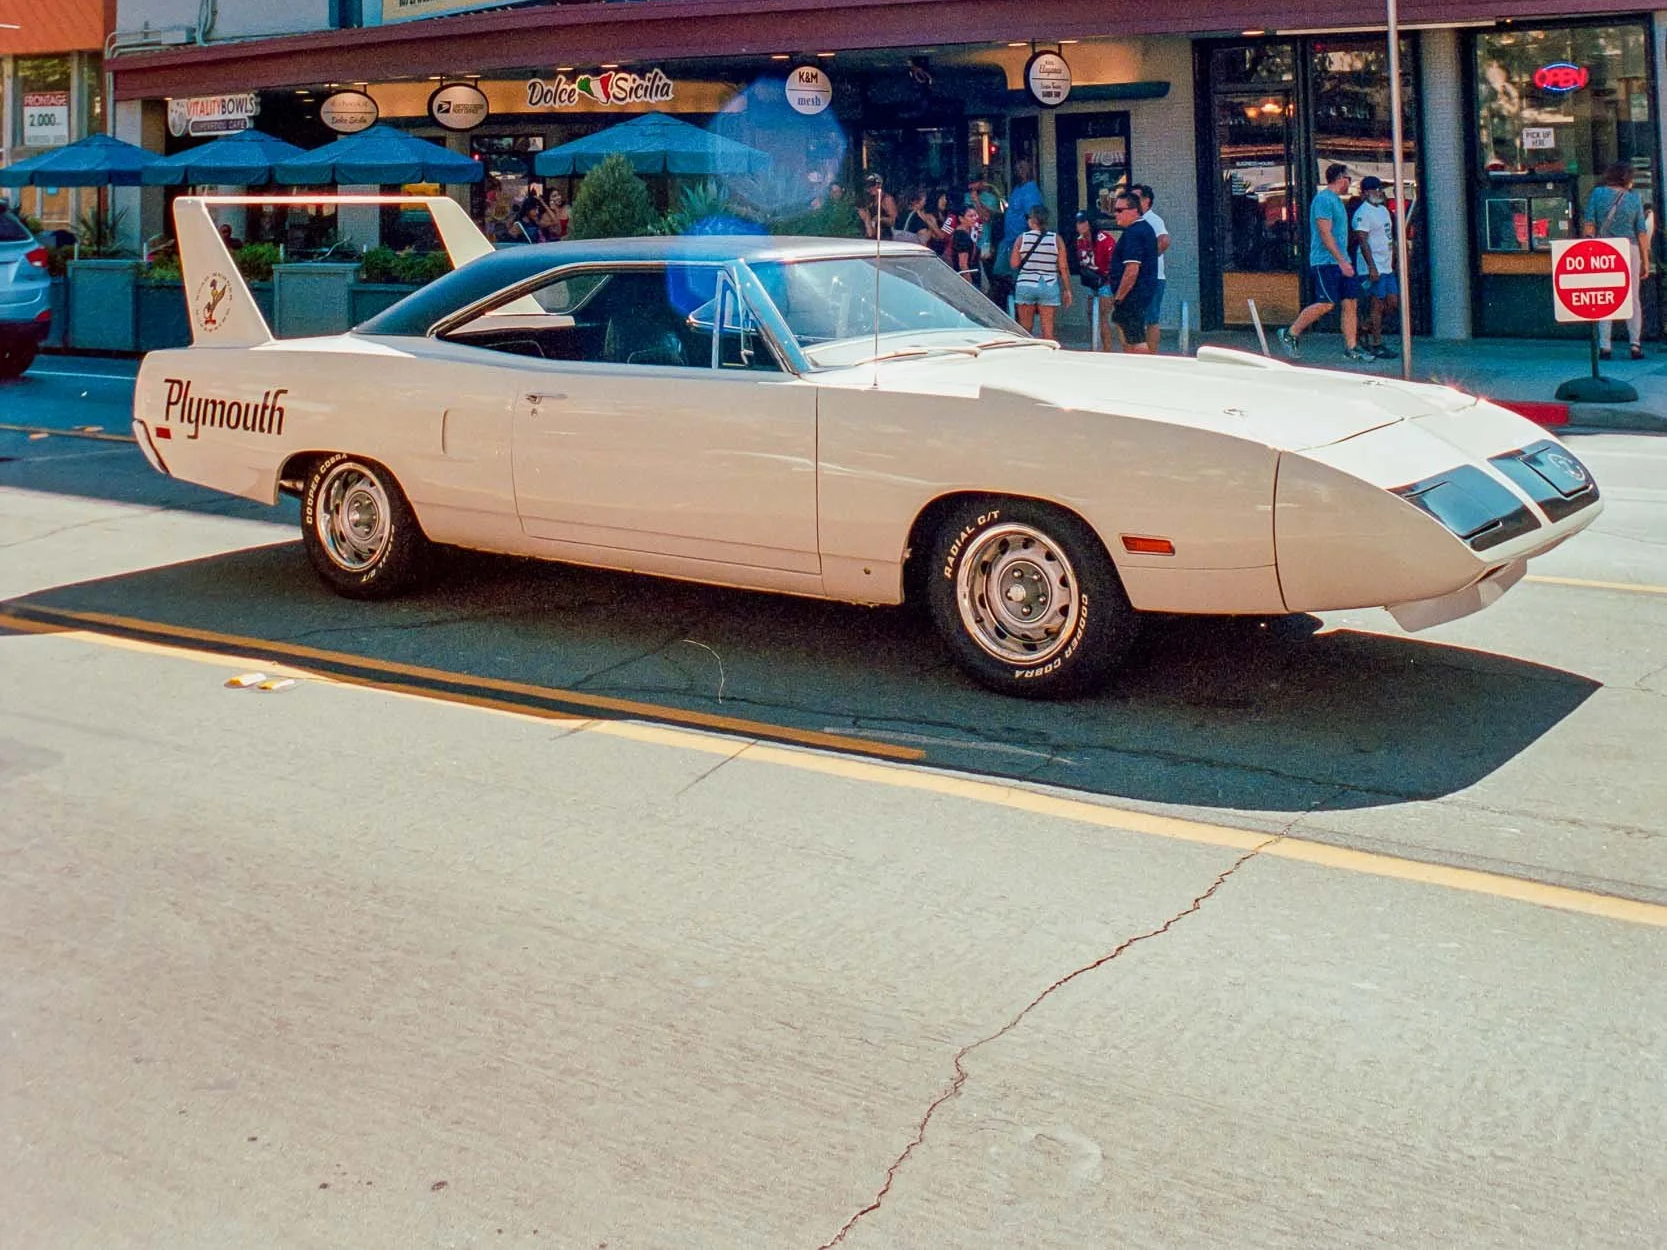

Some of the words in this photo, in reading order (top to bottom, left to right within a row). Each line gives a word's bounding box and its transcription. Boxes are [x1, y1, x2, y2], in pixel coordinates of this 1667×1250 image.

[528, 75, 576, 107] Dolce
[613, 69, 673, 102] Sicilia
[798, 71, 819, 83] K&M
[1534, 67, 1588, 88] OPEN
[797, 95, 821, 106] mesh
[1566, 256, 1585, 270] DO
[1590, 255, 1616, 270] NOT
[1571, 291, 1615, 306] ENTER
[163, 378, 289, 440] Plymouth
[305, 474, 321, 525] COOPER
[320, 453, 348, 473] COBRA
[943, 525, 976, 580] RADIAL
[977, 510, 1001, 526] G/T
[1064, 593, 1089, 659] COOPER
[1014, 657, 1062, 680] COBRA
